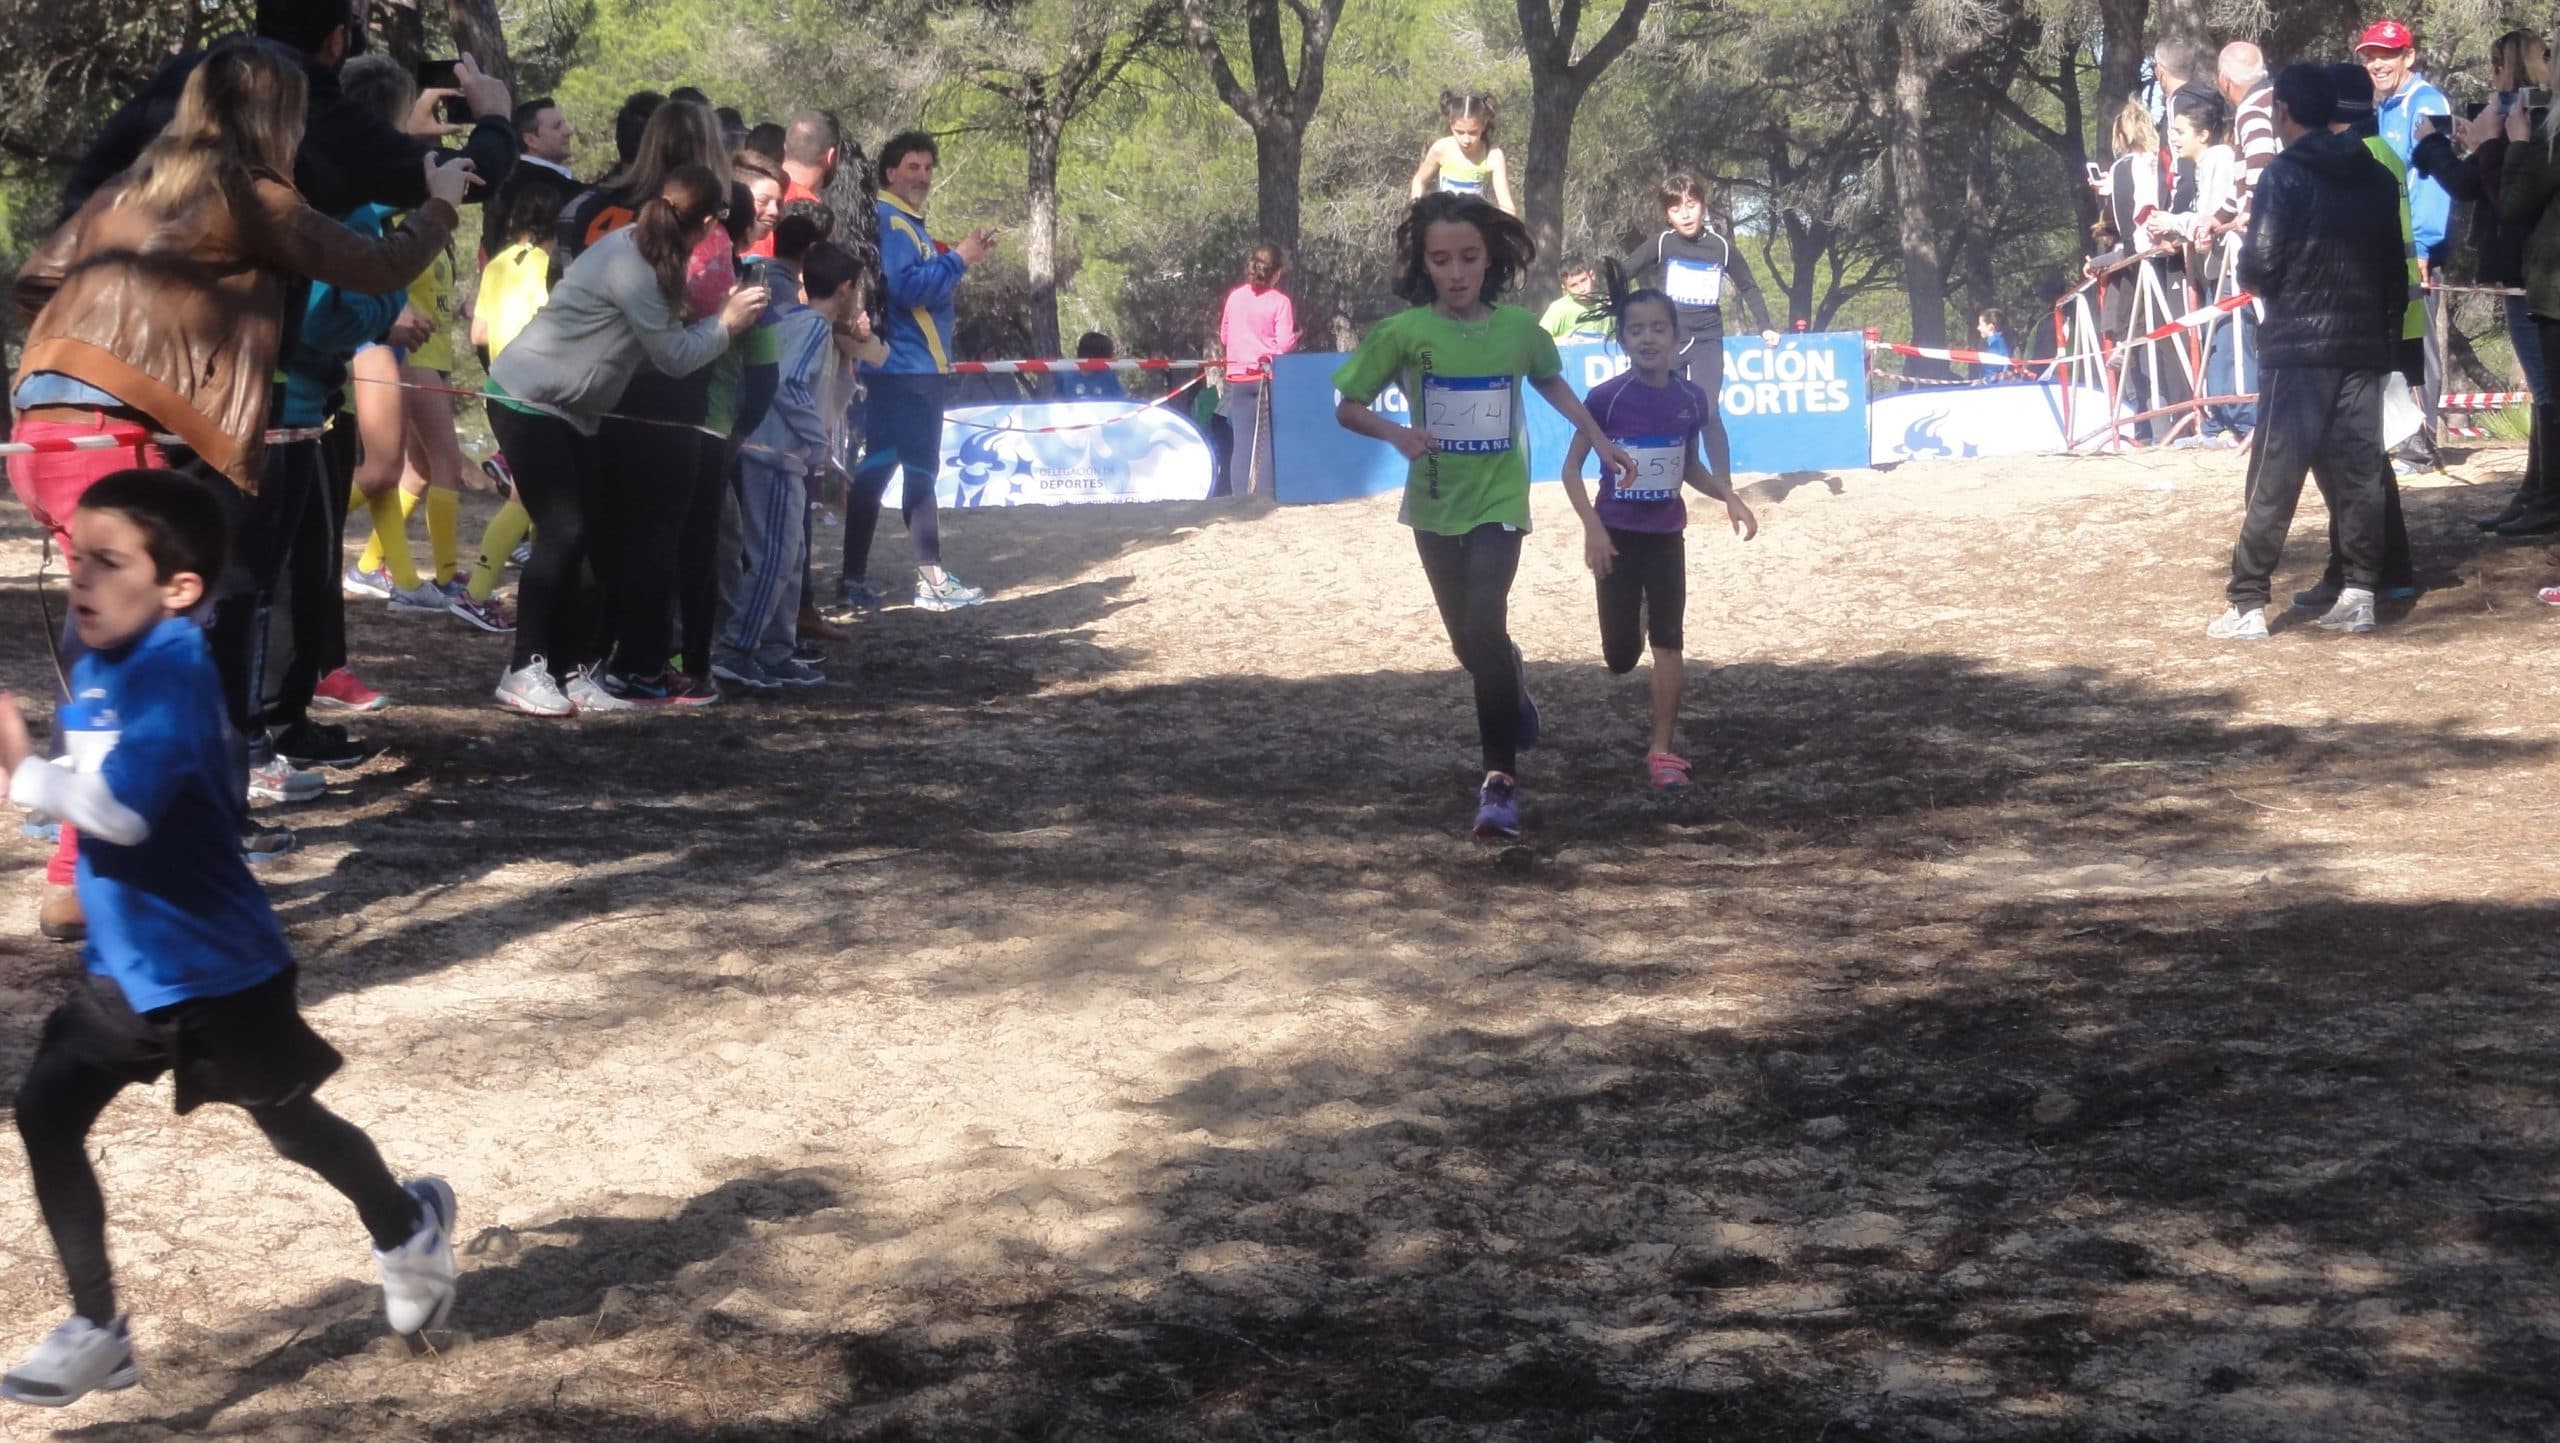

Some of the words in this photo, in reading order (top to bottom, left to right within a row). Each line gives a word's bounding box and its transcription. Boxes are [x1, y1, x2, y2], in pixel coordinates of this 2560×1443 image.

[1718, 379, 1850, 415] ORTES
[1431, 402, 1503, 427] 214
[1434, 439, 1510, 451] HICLANA
[1040, 479, 1104, 490] DEPORTES
